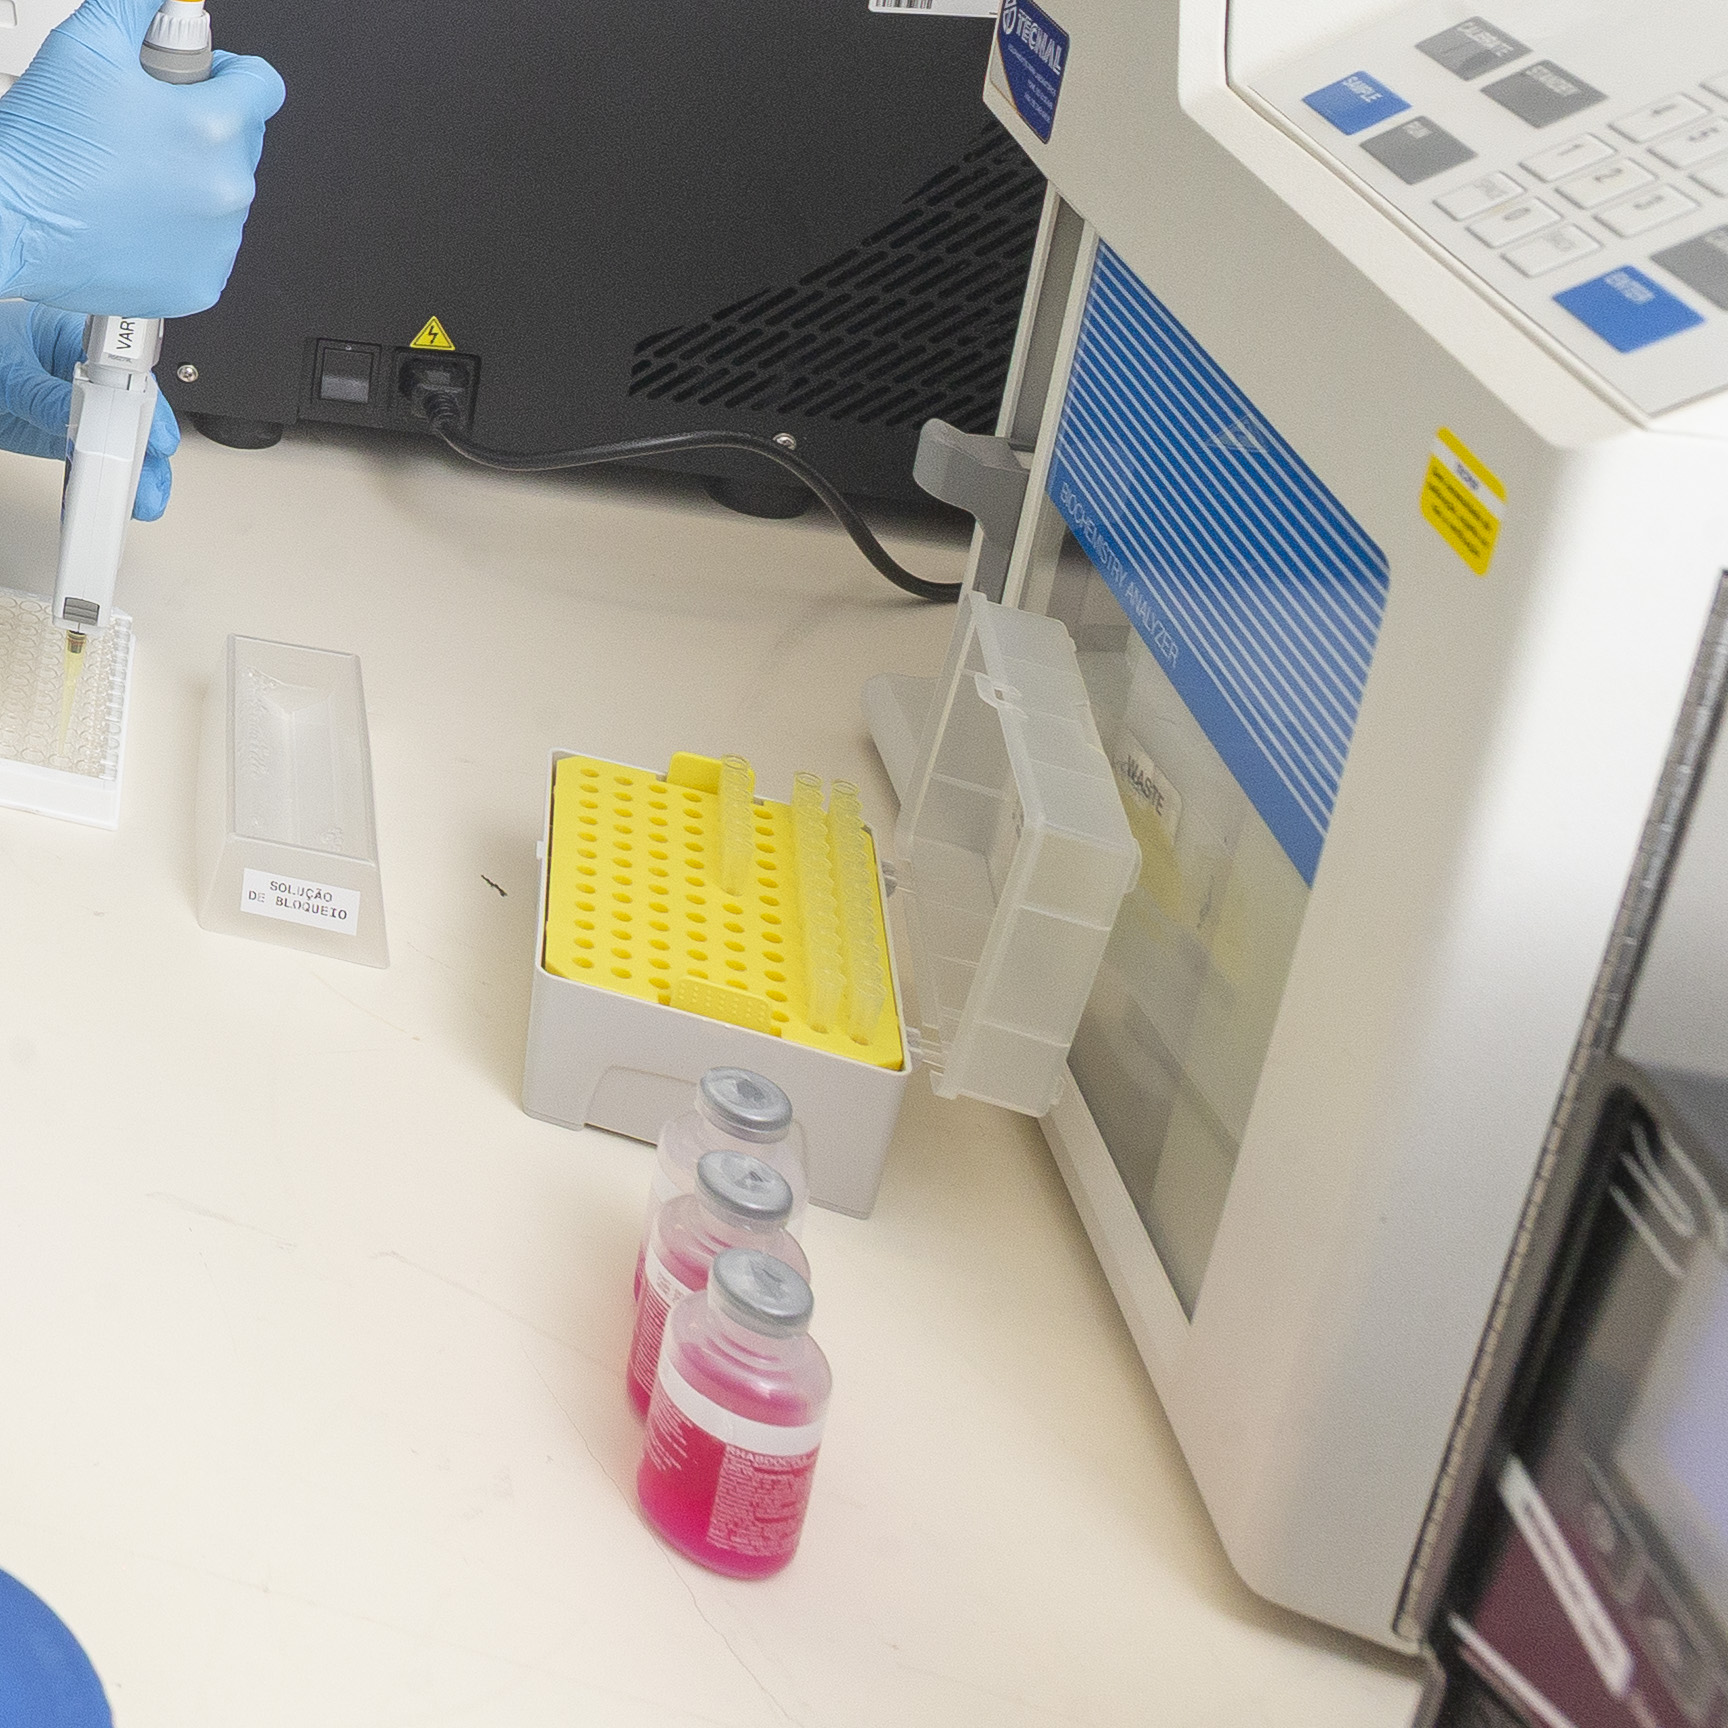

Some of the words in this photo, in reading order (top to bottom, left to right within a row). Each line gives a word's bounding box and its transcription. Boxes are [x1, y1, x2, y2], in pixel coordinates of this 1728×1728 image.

[1016, 8, 1063, 76] TECNAL
[1342, 75, 1384, 103] SAMPLE
[116, 316, 136, 351] VAR
[1060, 481, 1126, 587] BIOCHEMISTRY
[1125, 580, 1179, 670] ANALYZER
[1124, 754, 1165, 817] WASTE
[248, 890, 266, 903] DE
[275, 896, 348, 921] BLOQUEIO
[269, 880, 333, 903] SOLUÇÃO
